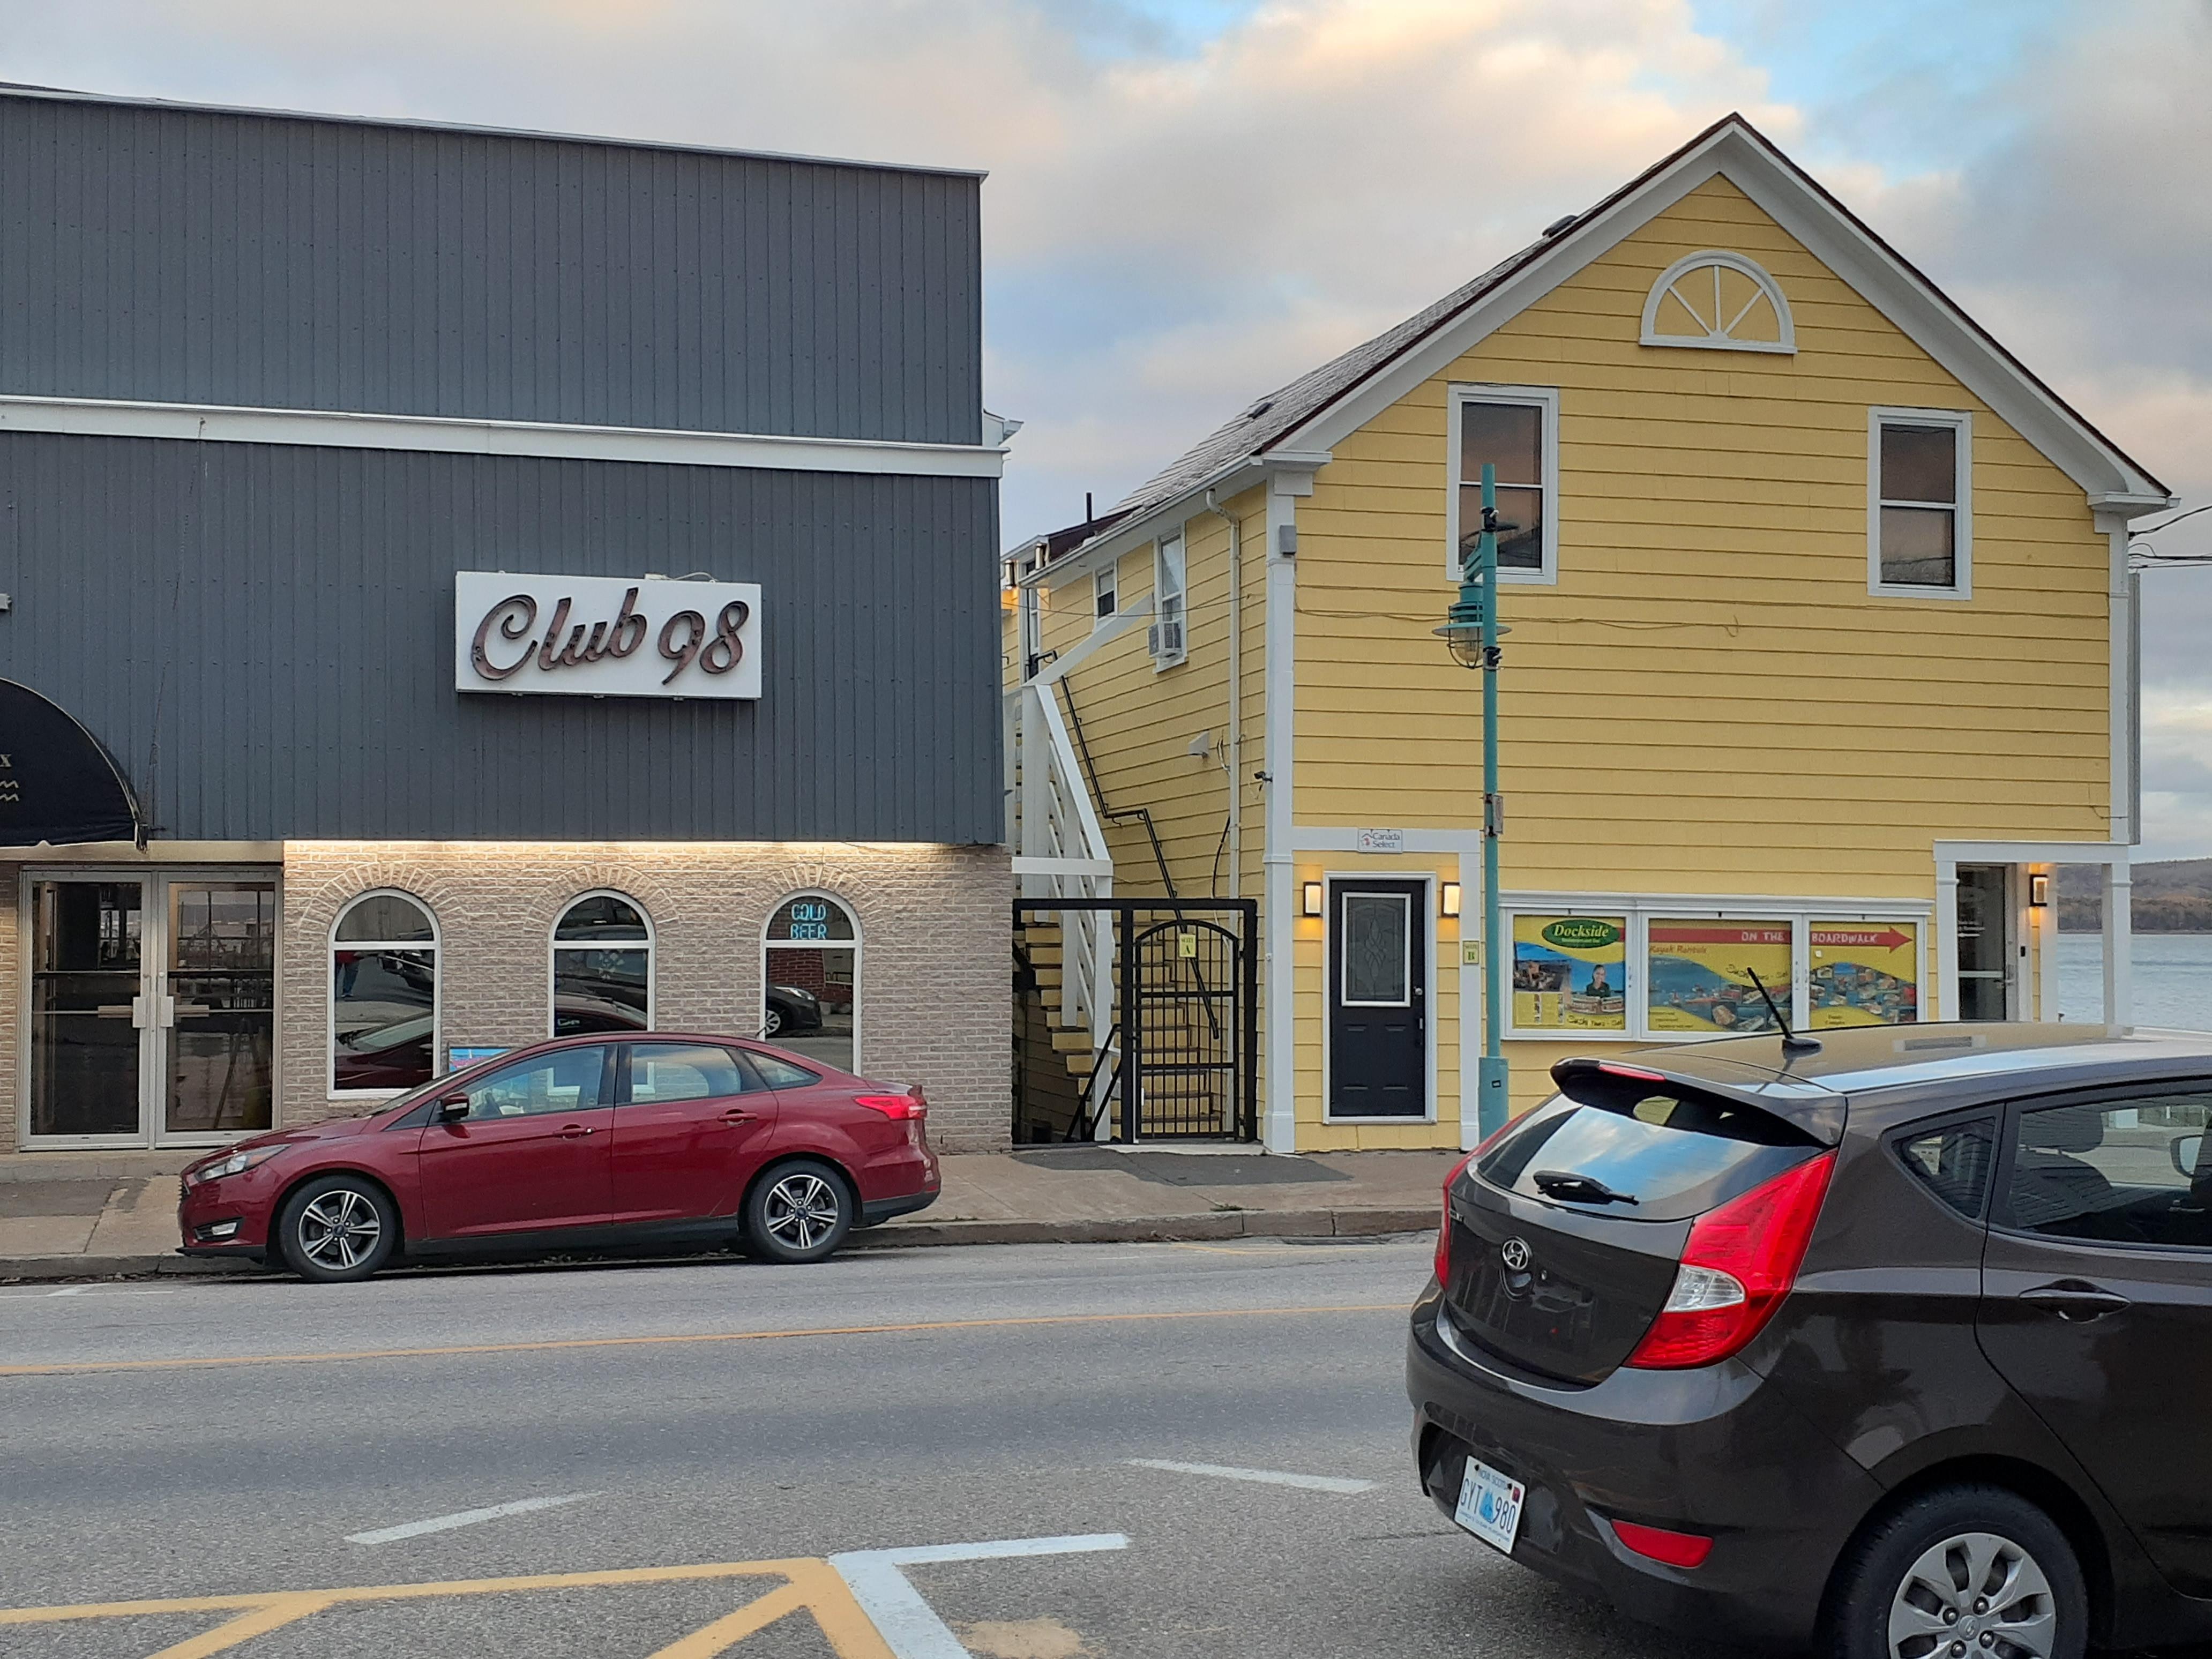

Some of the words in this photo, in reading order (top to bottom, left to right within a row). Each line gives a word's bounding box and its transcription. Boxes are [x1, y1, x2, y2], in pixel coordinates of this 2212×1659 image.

[471, 587, 647, 681] Club
[657, 601, 750, 685] 98
[791, 903, 826, 921] COLD
[790, 923, 827, 940] BEER
[1554, 924, 1609, 937] Dockside
[1742, 931, 1758, 941] ON
[1763, 931, 1784, 941] THE
[1812, 932, 1878, 944] BOARDWALK
[1460, 1478, 1483, 1514] GYT
[1488, 1496, 1516, 1534] 980
